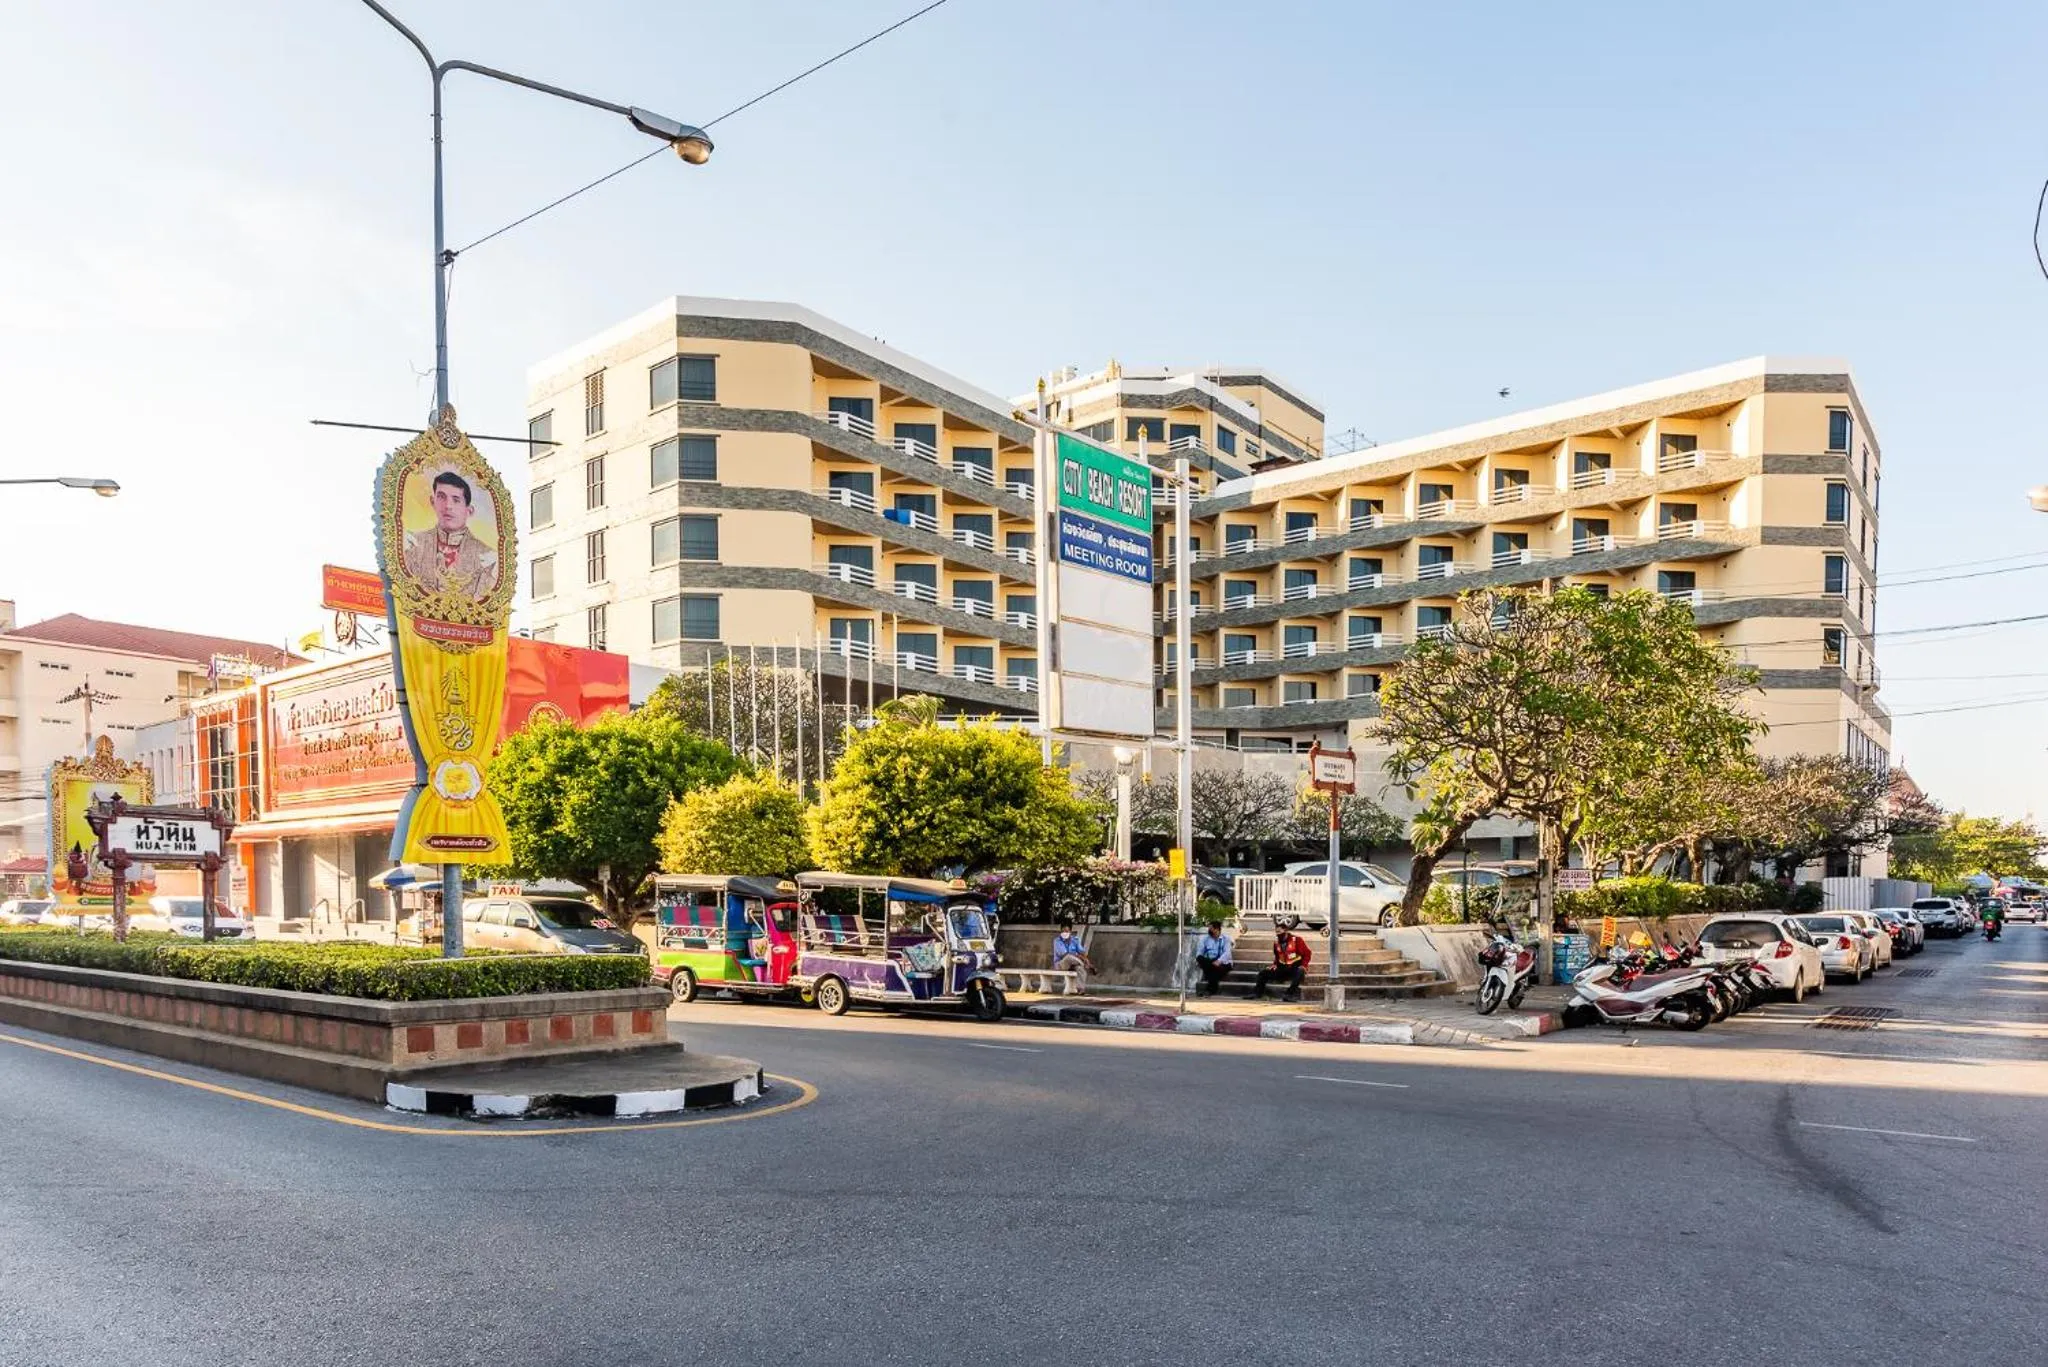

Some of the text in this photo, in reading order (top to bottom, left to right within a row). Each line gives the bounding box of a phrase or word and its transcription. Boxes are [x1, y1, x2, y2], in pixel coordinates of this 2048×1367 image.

[1063, 458, 1147, 520] CITY BEACH RESORT
[1064, 543, 1147, 577] MEETING ROOM
[420, 623, 489, 639] ทรงพระเจริญ
[136, 817, 196, 842] หัวหิน
[491, 885, 520, 896] TAXI
